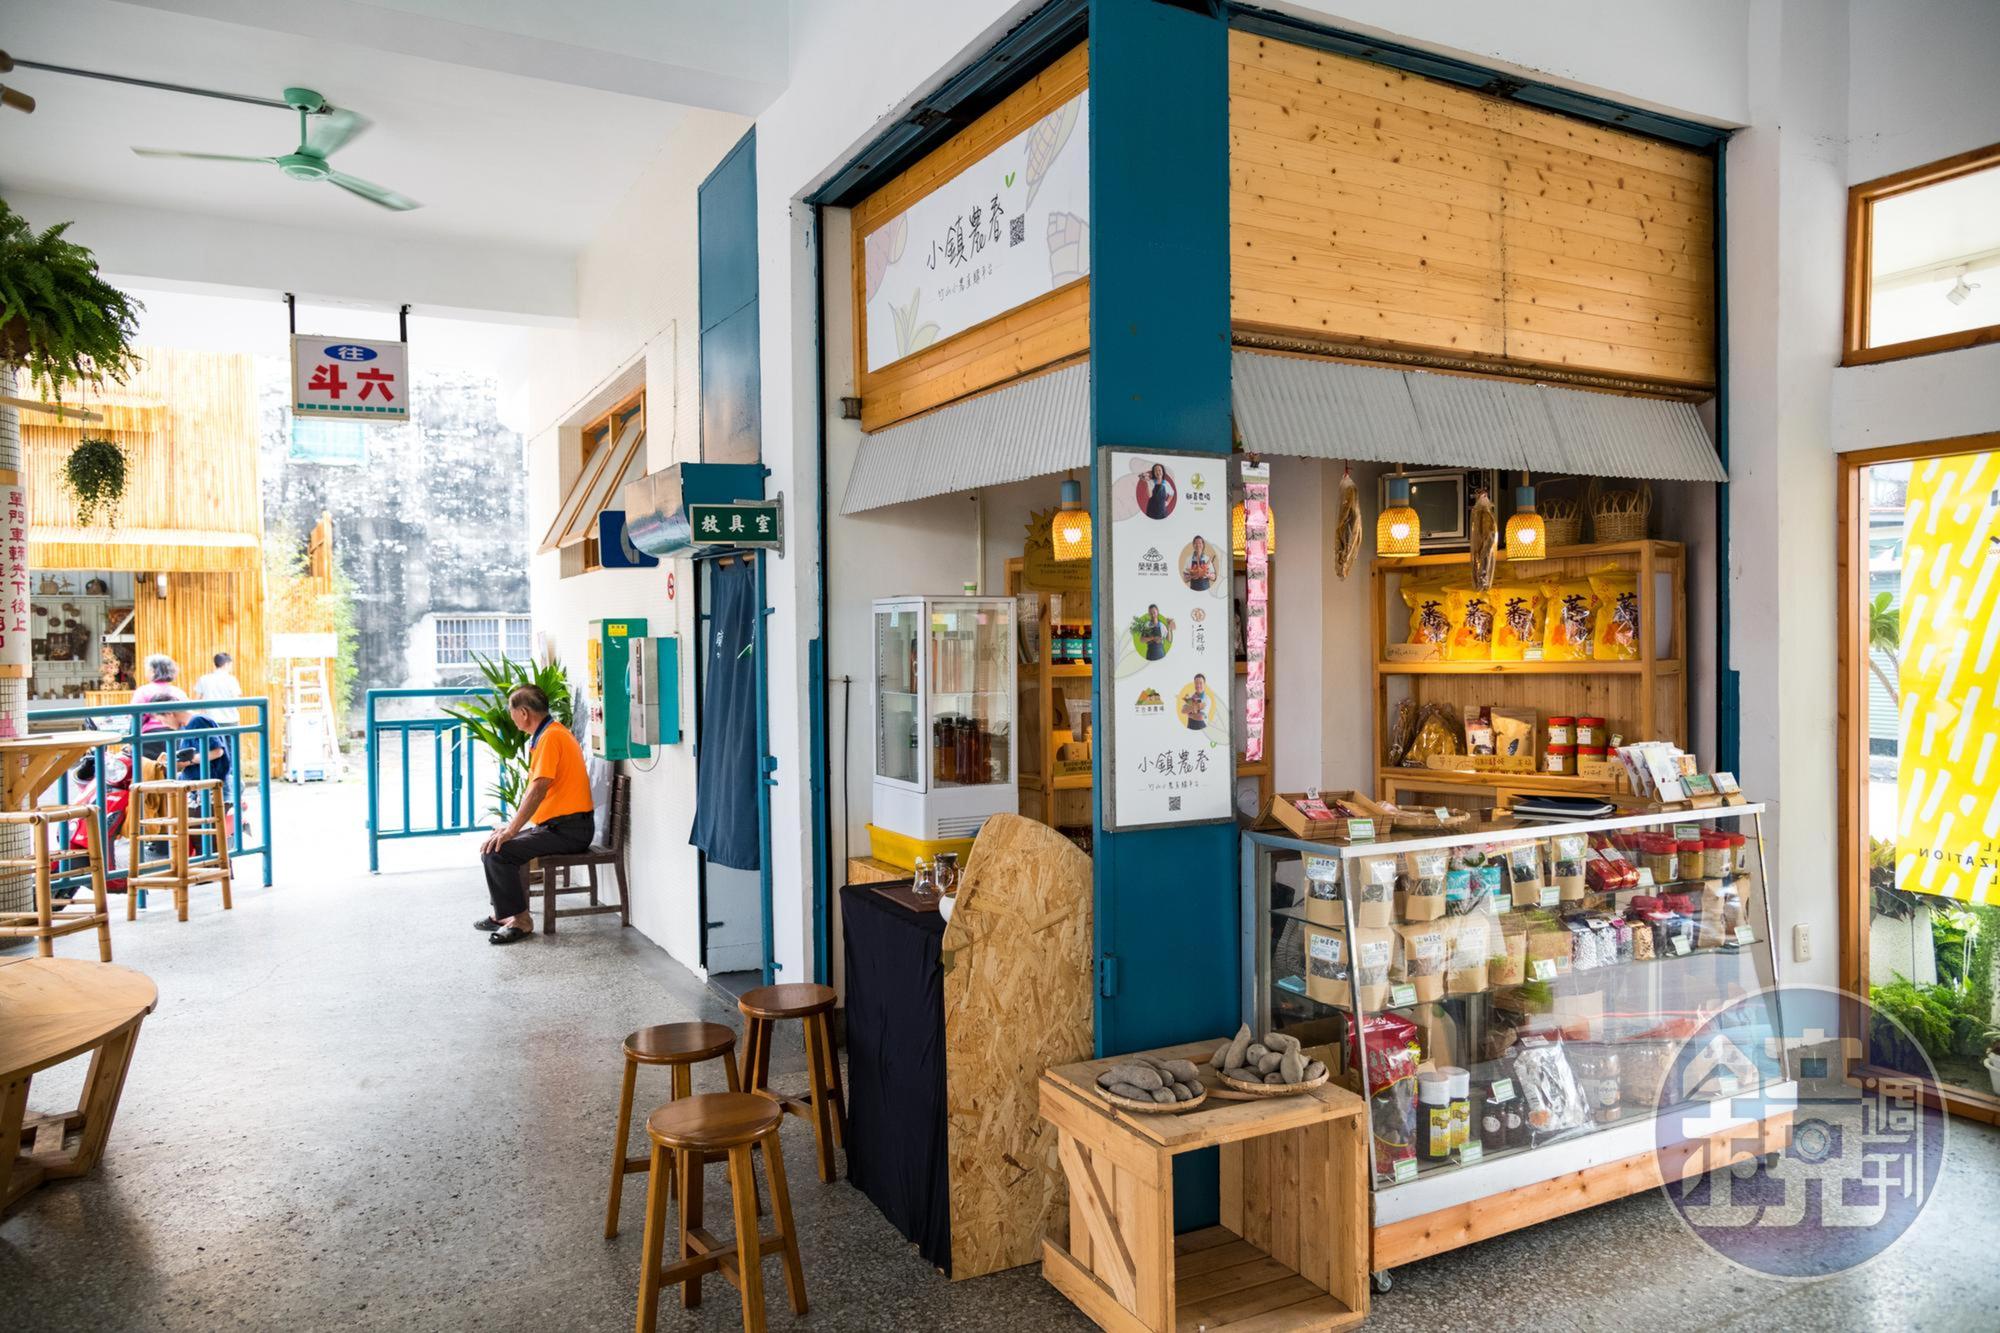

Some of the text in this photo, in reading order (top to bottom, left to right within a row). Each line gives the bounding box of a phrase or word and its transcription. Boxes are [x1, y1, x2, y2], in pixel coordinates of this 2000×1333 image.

[338, 346, 364, 360] 往
[308, 364, 395, 402] 斗六
[702, 514, 771, 533] 教具室
